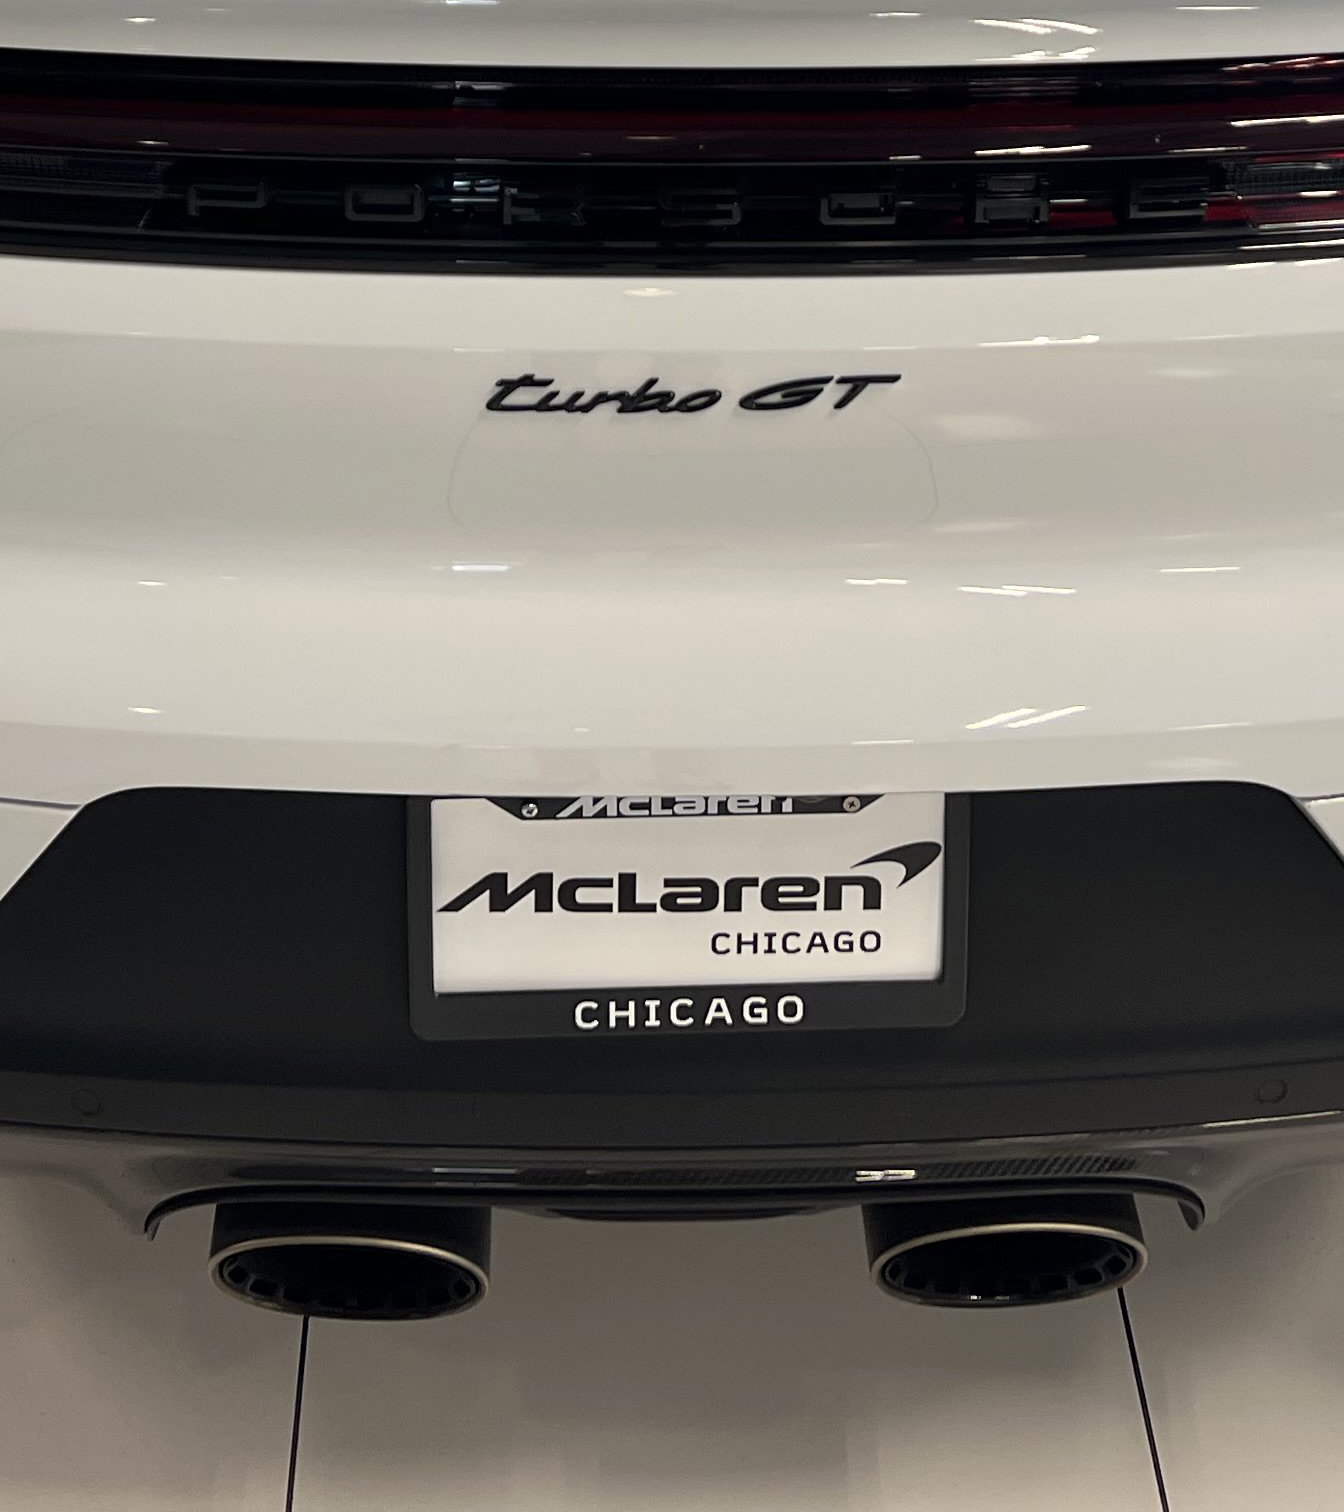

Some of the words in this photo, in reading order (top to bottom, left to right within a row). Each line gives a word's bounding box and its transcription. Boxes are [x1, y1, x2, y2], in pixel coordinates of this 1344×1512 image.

[186, 175, 1210, 228] PORSCHE
[484, 373, 723, 414] turbo
[737, 373, 903, 410] GT
[556, 796, 794, 818] McLaren
[436, 871, 883, 913] McLaren
[710, 930, 883, 955] CHICAGO
[574, 994, 805, 1030] CHICAGO
